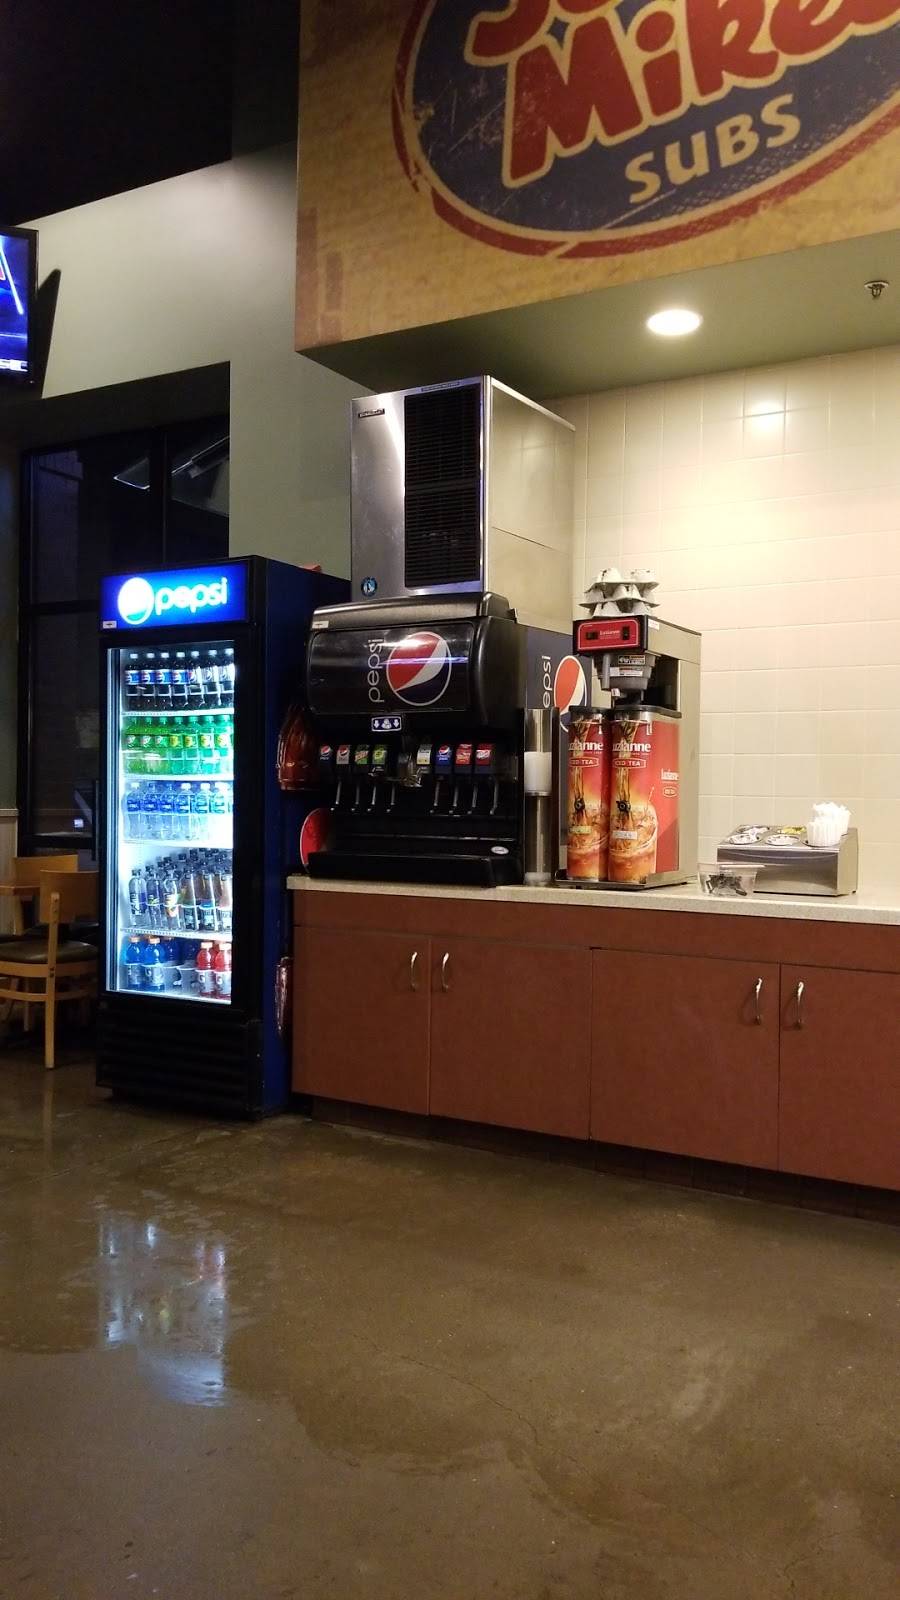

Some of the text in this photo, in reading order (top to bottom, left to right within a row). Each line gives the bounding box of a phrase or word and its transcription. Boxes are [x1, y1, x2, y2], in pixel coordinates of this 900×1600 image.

[505, 0, 900, 186] Mike
[624, 93, 801, 204] SUBS
[155, 576, 228, 616] pepsi
[367, 638, 385, 703] pepsi
[541, 655, 553, 709] epsi
